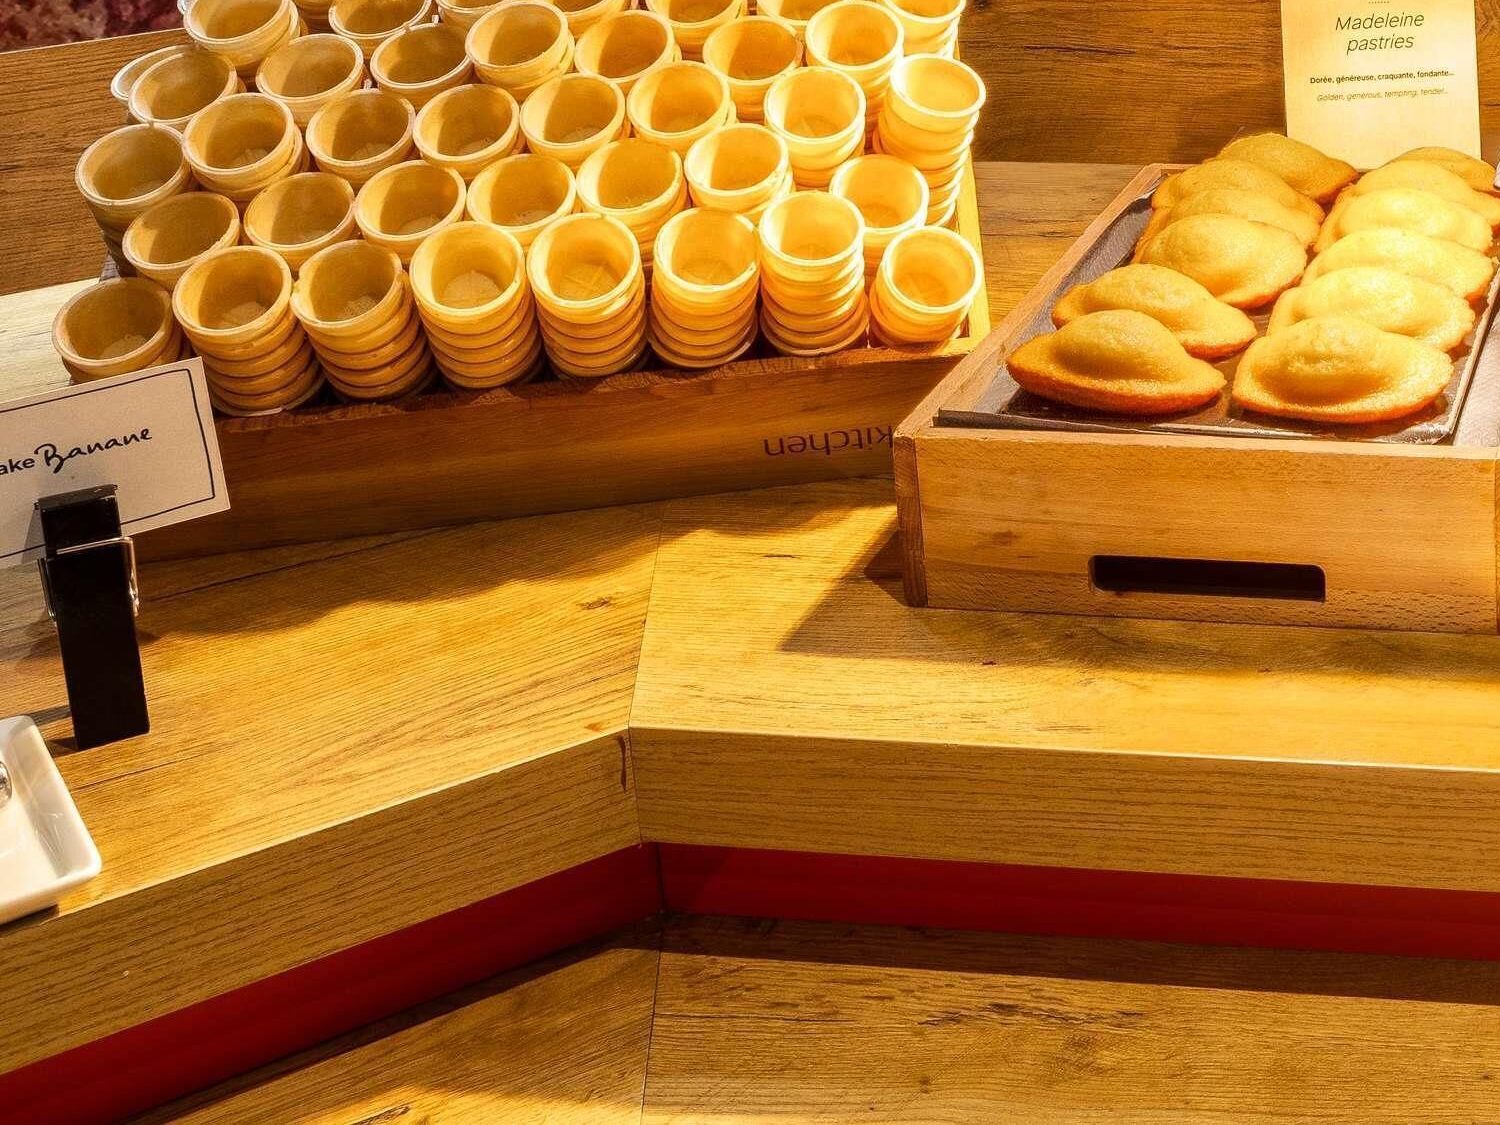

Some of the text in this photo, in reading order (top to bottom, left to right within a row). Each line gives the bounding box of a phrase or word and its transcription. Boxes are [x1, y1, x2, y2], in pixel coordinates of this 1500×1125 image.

[1335, 12, 1425, 31] Madeleine
[1346, 34, 1414, 55] pastries
[1310, 76, 1335, 84] Dorée,
[34, 428, 152, 474] Banane
[764, 425, 893, 456] kitchen
